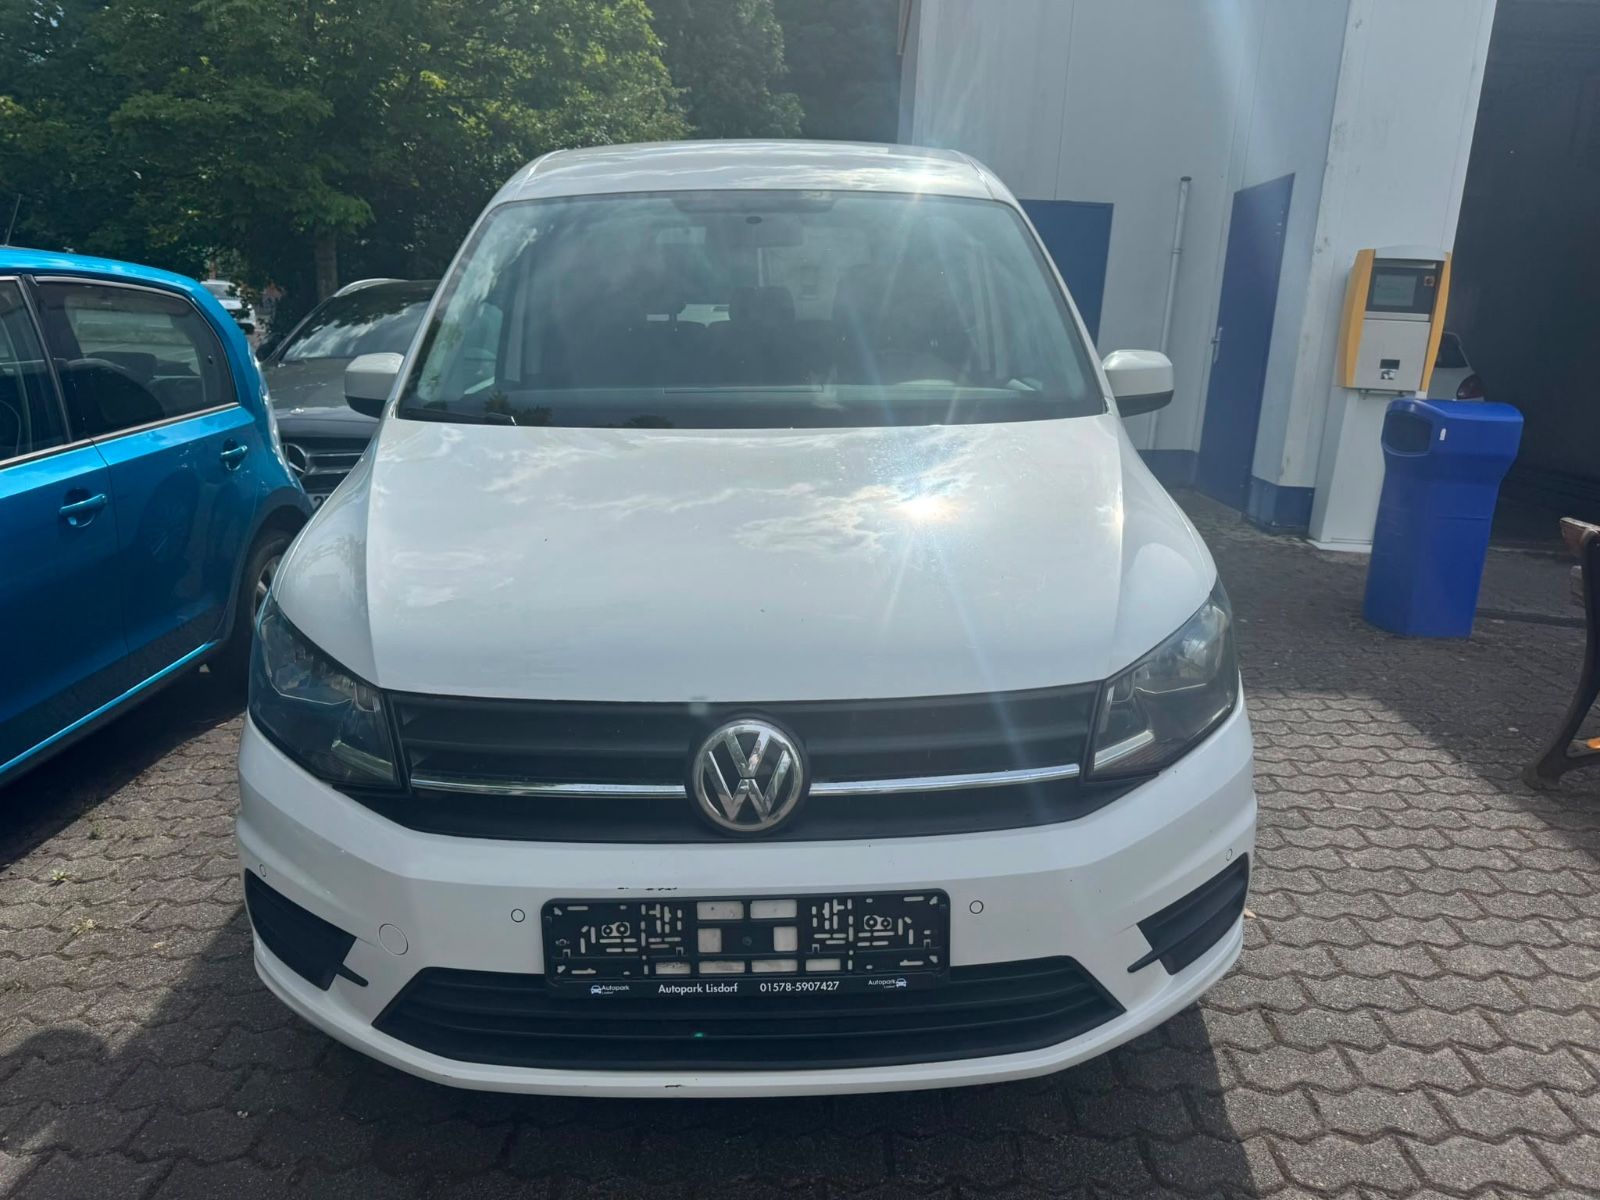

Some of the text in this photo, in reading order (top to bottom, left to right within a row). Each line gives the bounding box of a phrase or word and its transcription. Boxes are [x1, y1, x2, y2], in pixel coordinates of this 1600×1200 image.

[702, 727, 792, 823] VW
[658, 981, 840, 996] Autopark Lisdorf 01578-5907427
